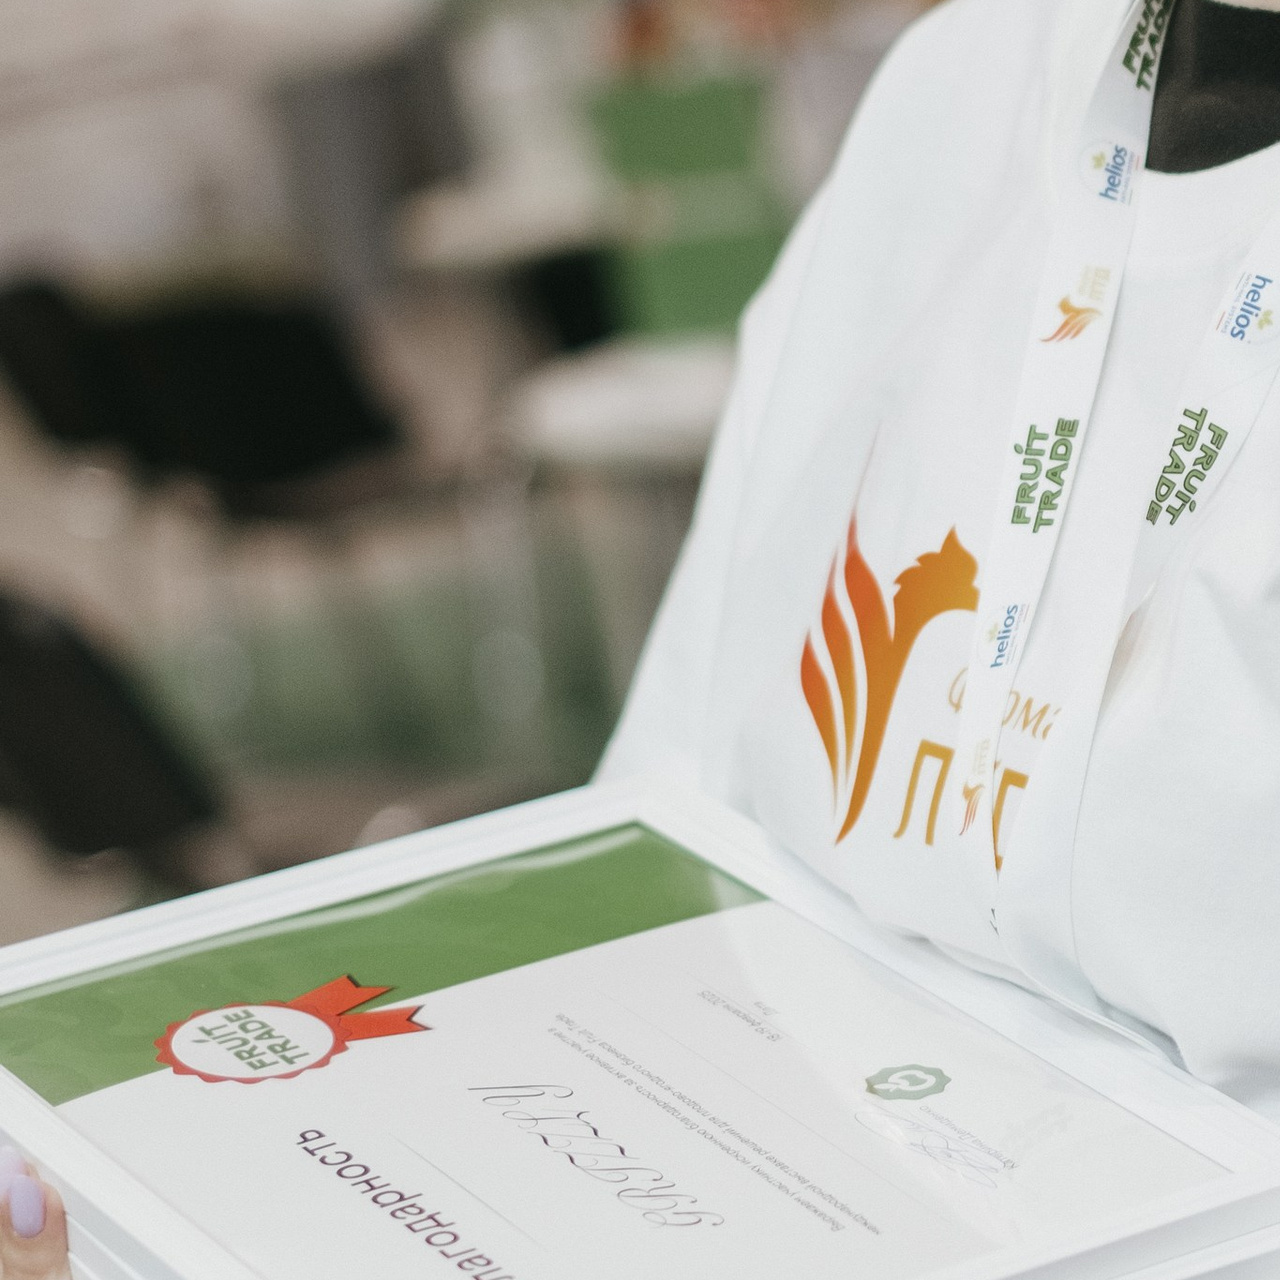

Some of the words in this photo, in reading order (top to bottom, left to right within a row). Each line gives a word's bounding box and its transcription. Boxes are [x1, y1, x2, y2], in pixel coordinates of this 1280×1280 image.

[1099, 144, 1127, 202] helios
[1230, 274, 1273, 342] helios
[1011, 424, 1049, 525] FRUIT
[1033, 418, 1080, 533] TRADE
[1146, 407, 1208, 525] TRADE
[1166, 422, 1228, 525] FRUIT
[990, 604, 1018, 668] helios
[191, 1025, 278, 1071] FRUIT
[224, 1009, 309, 1065] TRADE
